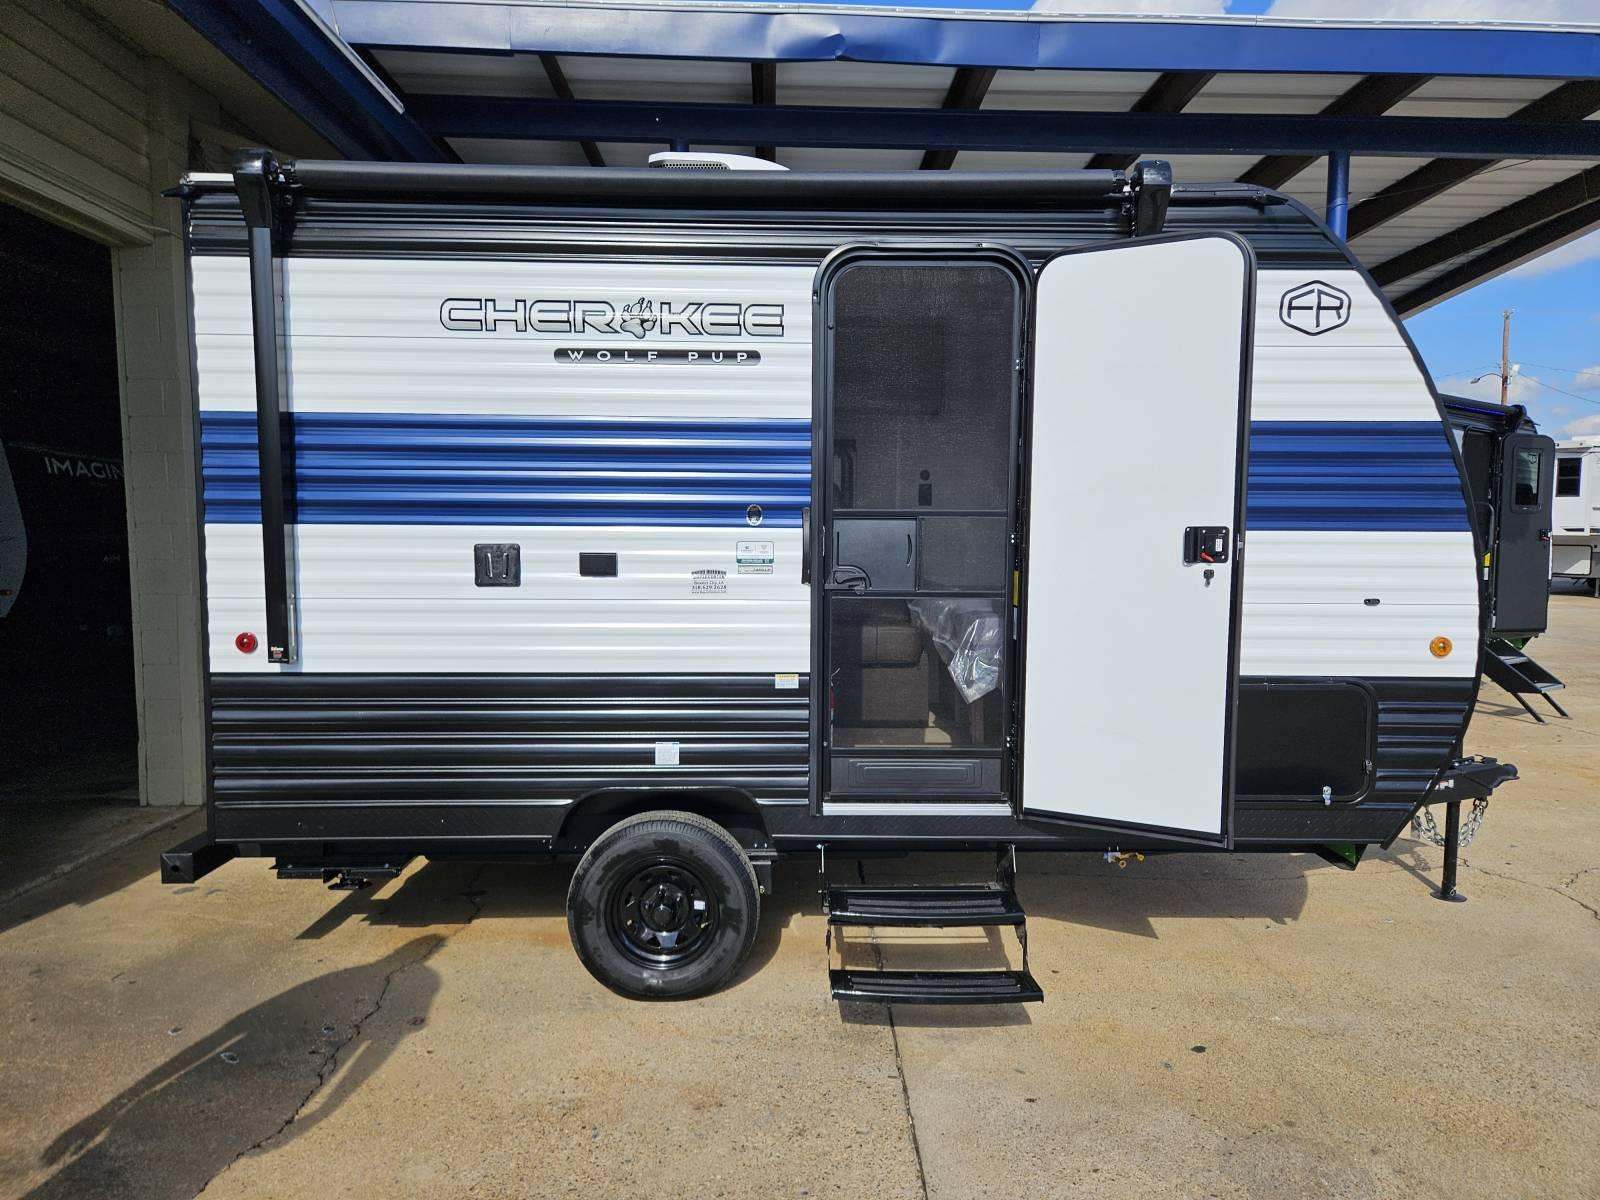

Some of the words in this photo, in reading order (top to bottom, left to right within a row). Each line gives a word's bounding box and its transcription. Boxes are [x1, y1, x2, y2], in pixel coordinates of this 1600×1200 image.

[439, 297, 786, 339] CHERKEE
[567, 350, 658, 363] WOLF
[688, 351, 748, 364] PUP
